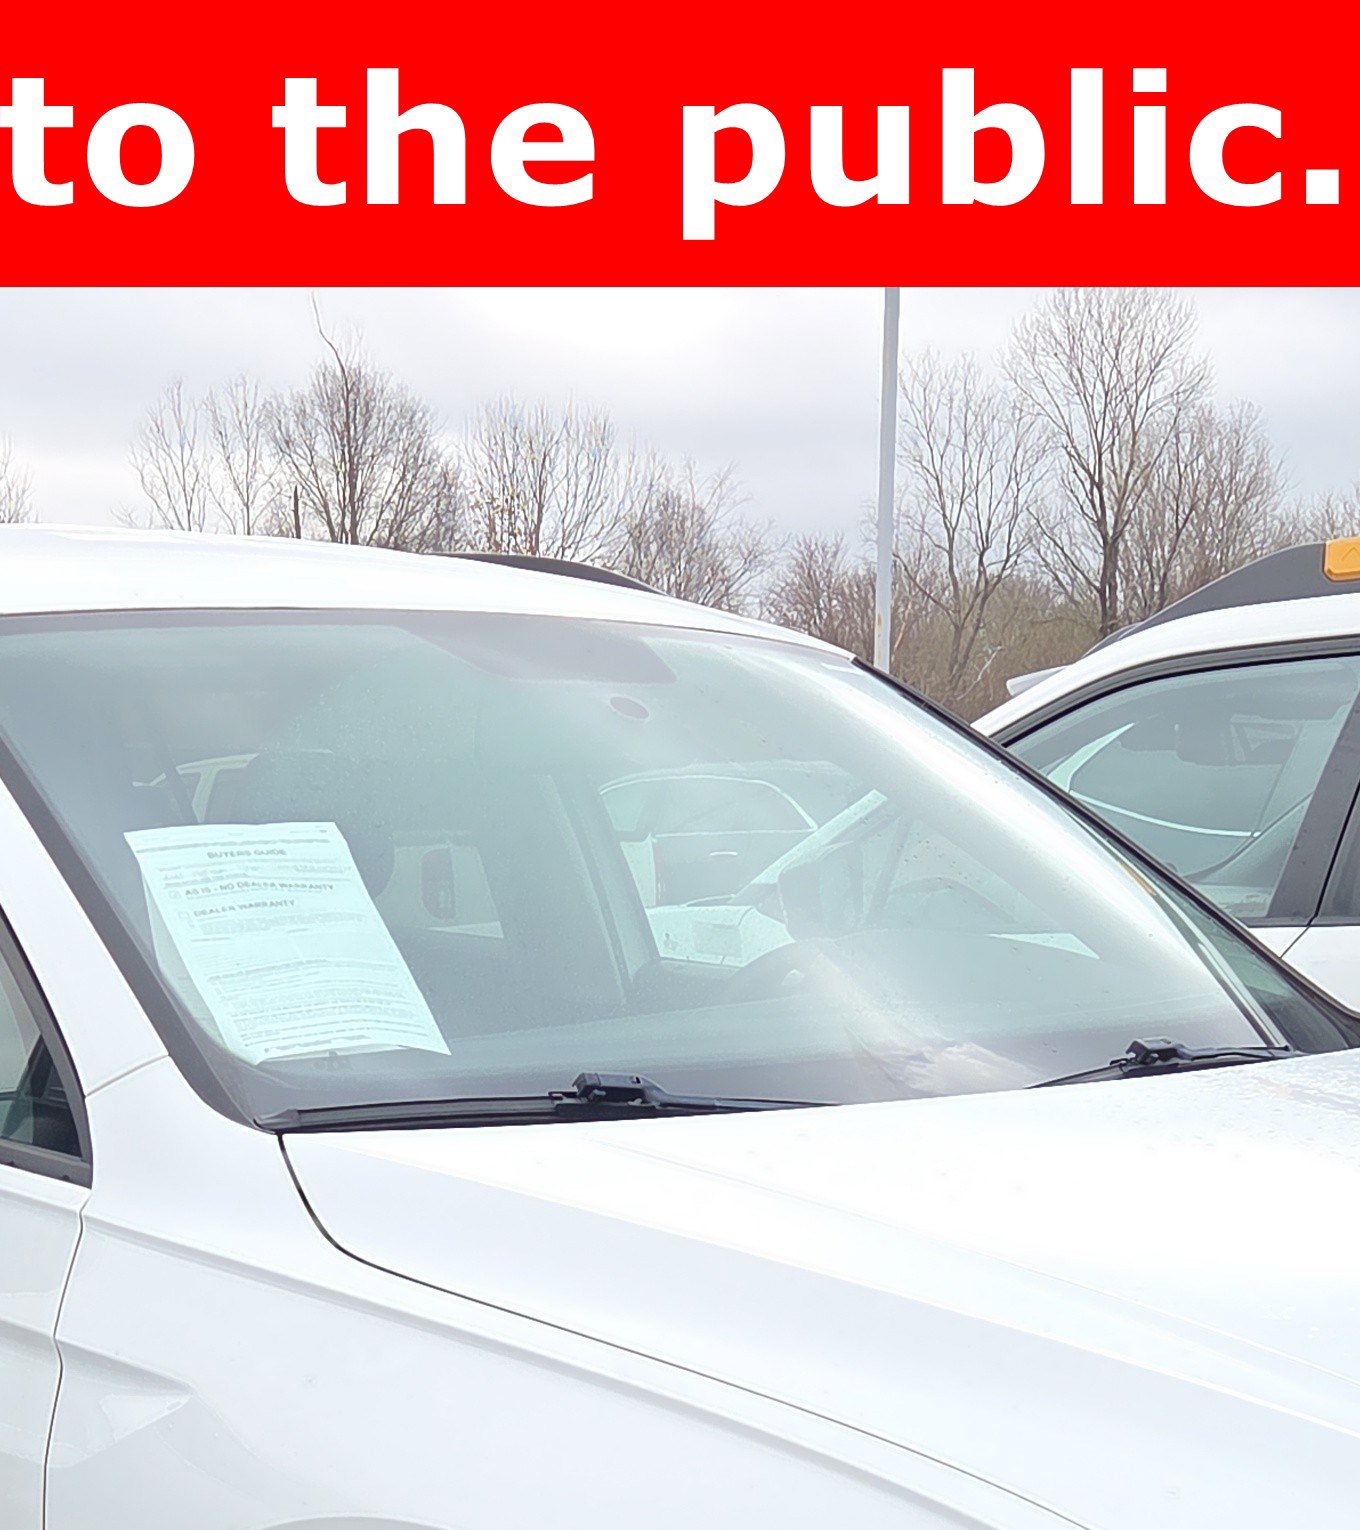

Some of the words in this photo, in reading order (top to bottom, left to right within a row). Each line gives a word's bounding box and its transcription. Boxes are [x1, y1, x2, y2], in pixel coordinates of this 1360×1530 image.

[254, 848, 288, 856] GUIDE
[237, 881, 276, 889] DEALER
[193, 905, 236, 917] DEALER
